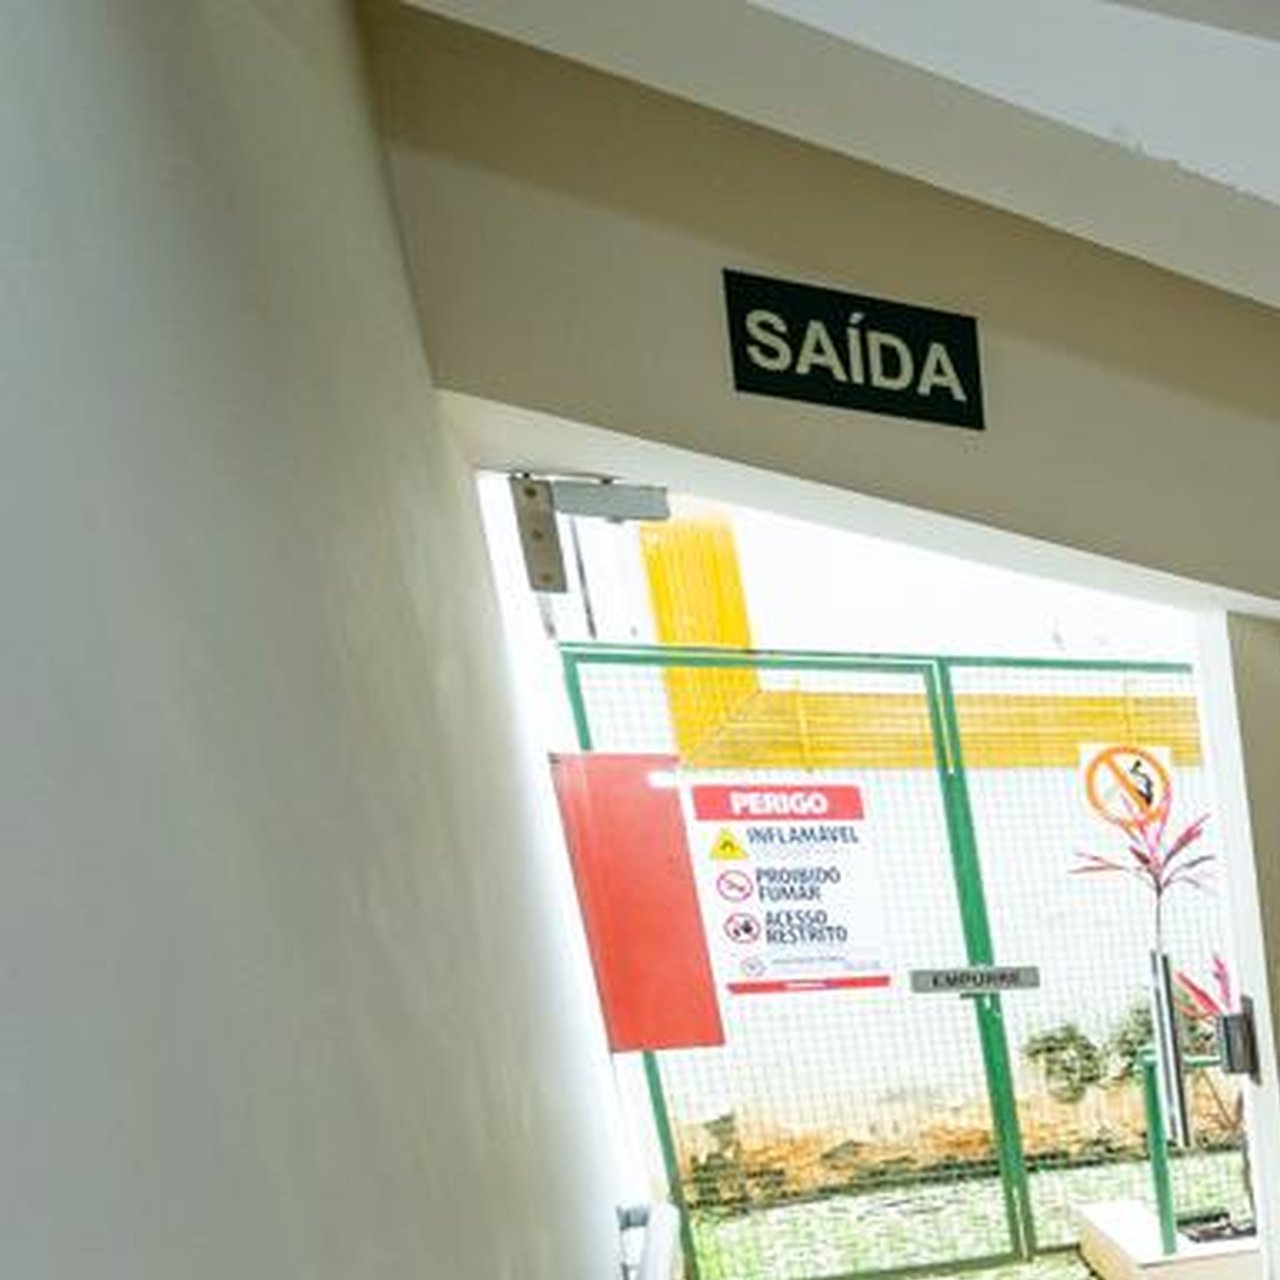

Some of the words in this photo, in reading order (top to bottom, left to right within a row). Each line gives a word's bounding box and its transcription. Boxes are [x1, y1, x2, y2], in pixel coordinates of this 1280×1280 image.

[744, 309, 968, 402] SAÍDA
[729, 791, 829, 815] PERIGO
[746, 825, 860, 845] INFLAMÁVEL
[755, 866, 842, 884] PROIBIDO
[758, 885, 822, 901] FUMAR
[765, 909, 828, 926] ACESSO
[765, 926, 848, 944] RESTRITO
